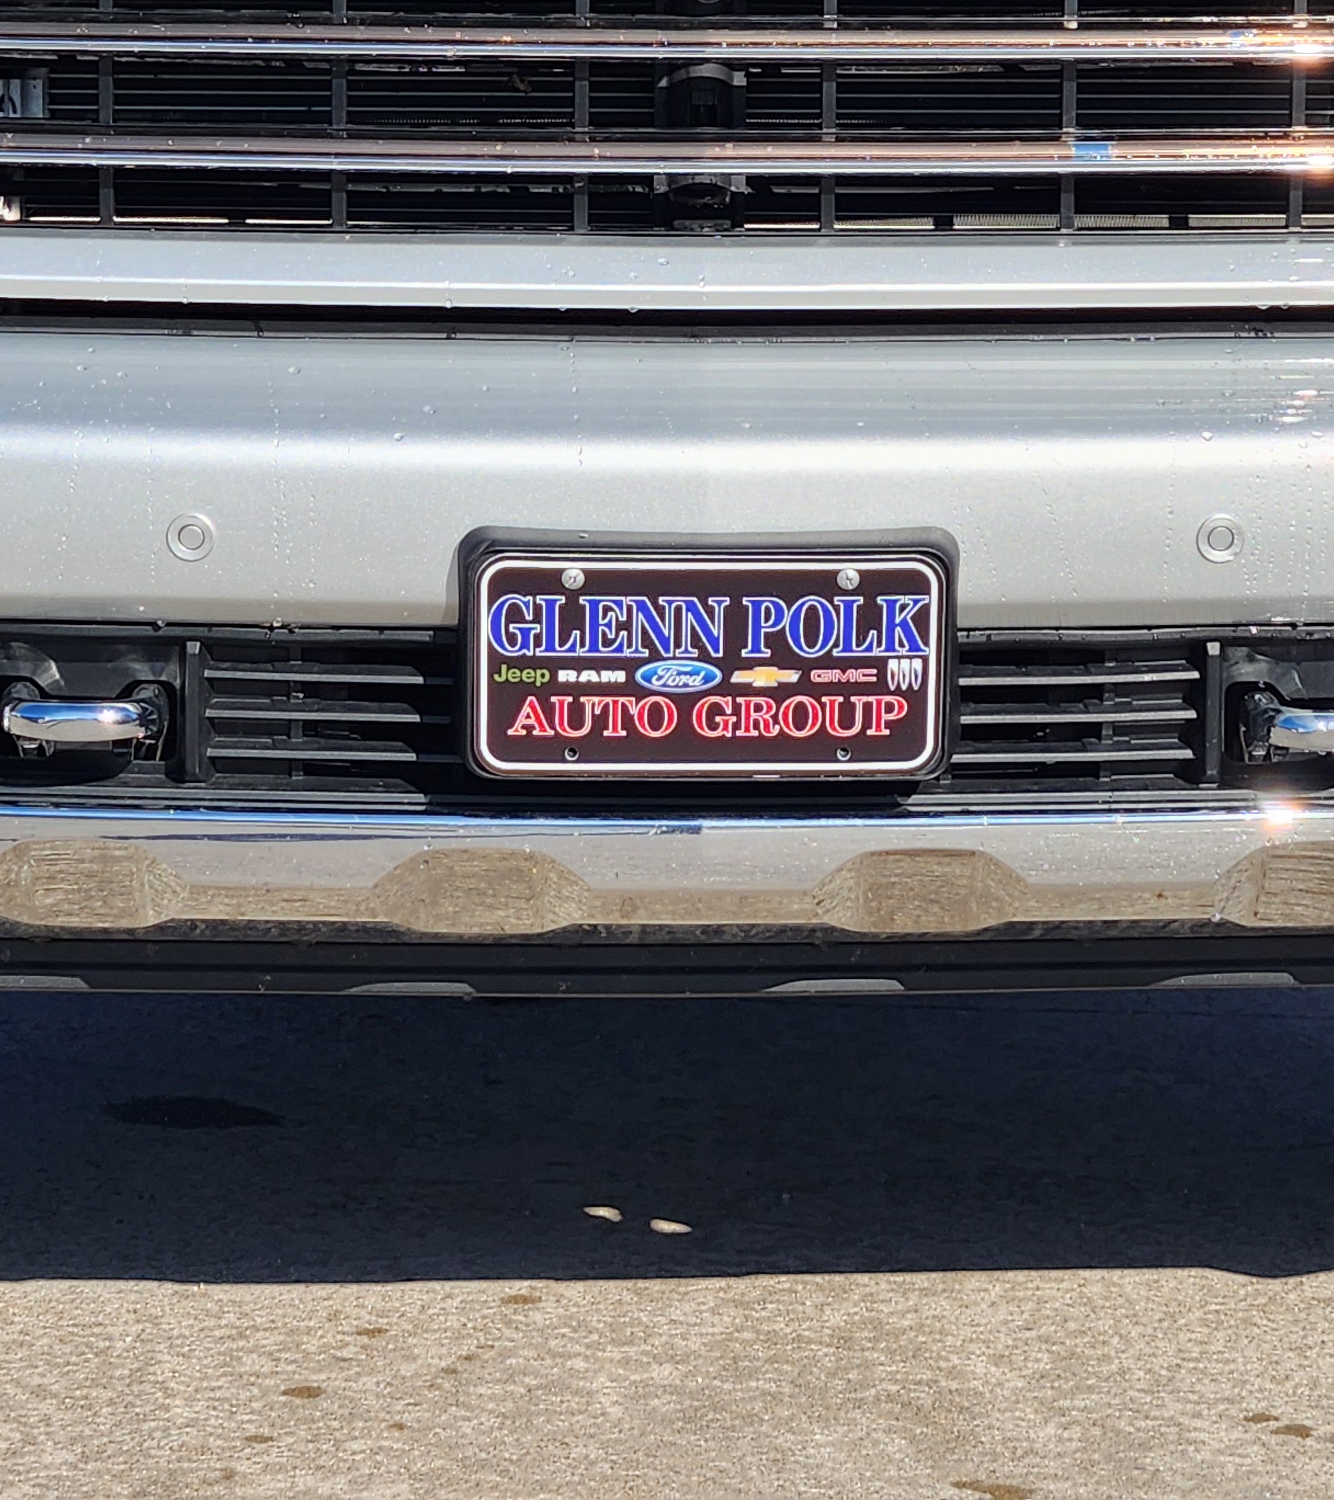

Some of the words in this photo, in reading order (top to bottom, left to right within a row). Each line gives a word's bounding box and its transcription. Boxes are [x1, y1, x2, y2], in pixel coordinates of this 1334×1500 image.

[488, 593, 730, 658] GLENN
[742, 594, 930, 658] POLK
[493, 664, 551, 687] Jeep
[557, 669, 626, 683] RAM
[650, 665, 705, 687] Ford
[810, 668, 878, 683] GMC
[507, 695, 677, 737] AUTO
[692, 695, 908, 737] GROUP
